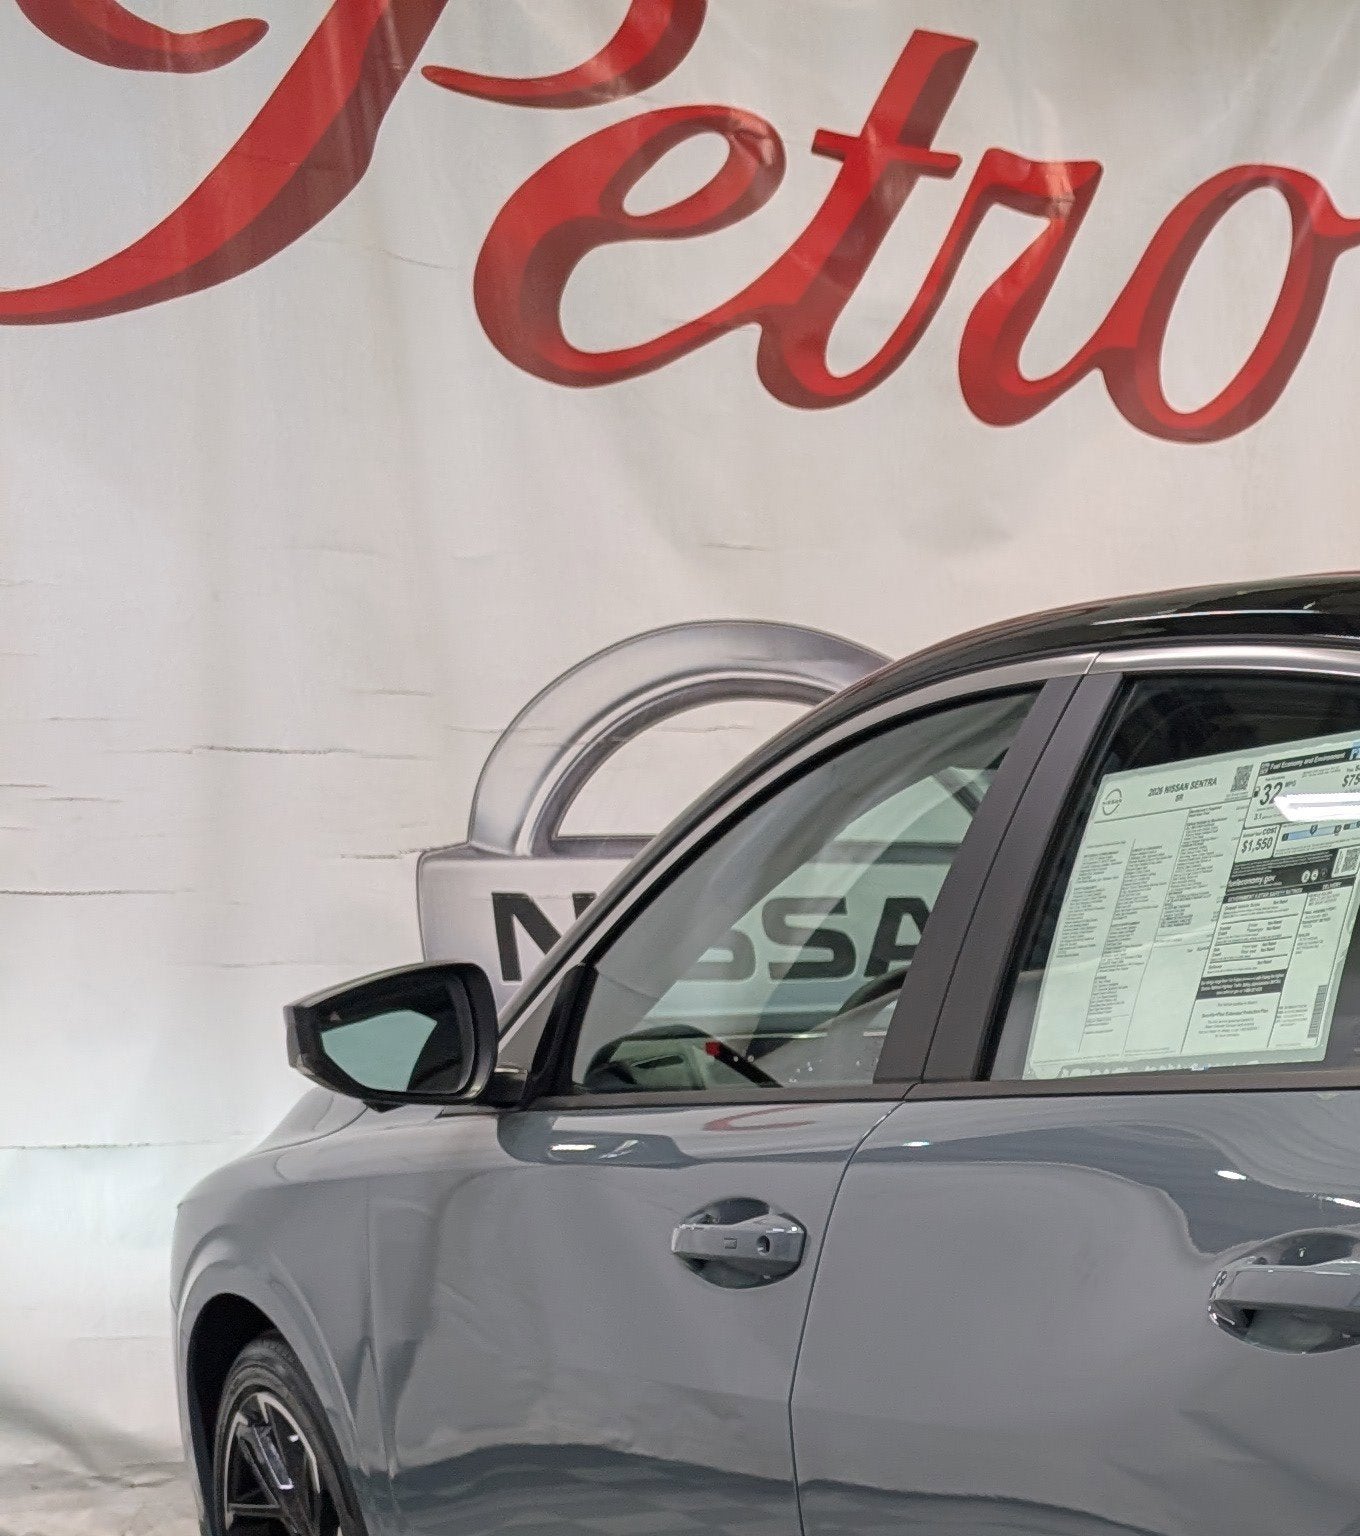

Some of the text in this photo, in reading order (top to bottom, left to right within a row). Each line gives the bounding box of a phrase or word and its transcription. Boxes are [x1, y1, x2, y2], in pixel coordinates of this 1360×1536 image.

[1164, 782, 1189, 795] NISSAN
[1189, 777, 1217, 791] SENTRA
[1259, 781, 1283, 806] 32
[1241, 836, 1273, 854] $1,550
